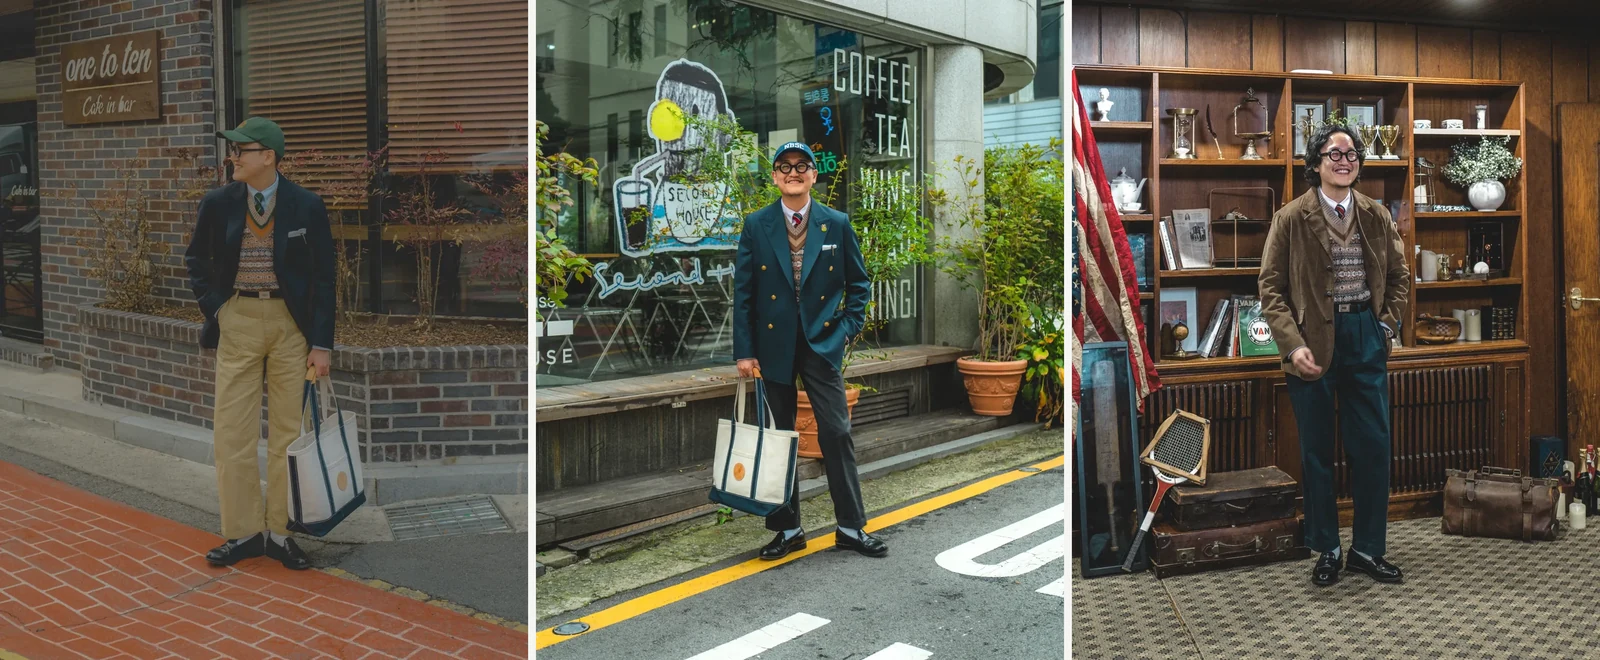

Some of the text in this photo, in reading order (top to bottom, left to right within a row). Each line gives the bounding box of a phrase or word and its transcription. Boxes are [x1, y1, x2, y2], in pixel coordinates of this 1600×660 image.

[66, 40, 152, 82] one to ten
[834, 48, 911, 104] COFFEE
[83, 94, 136, 117] Cafe in bar
[875, 113, 911, 158] TEA
[594, 258, 704, 299] Second
[1253, 327, 1270, 336] VAN
